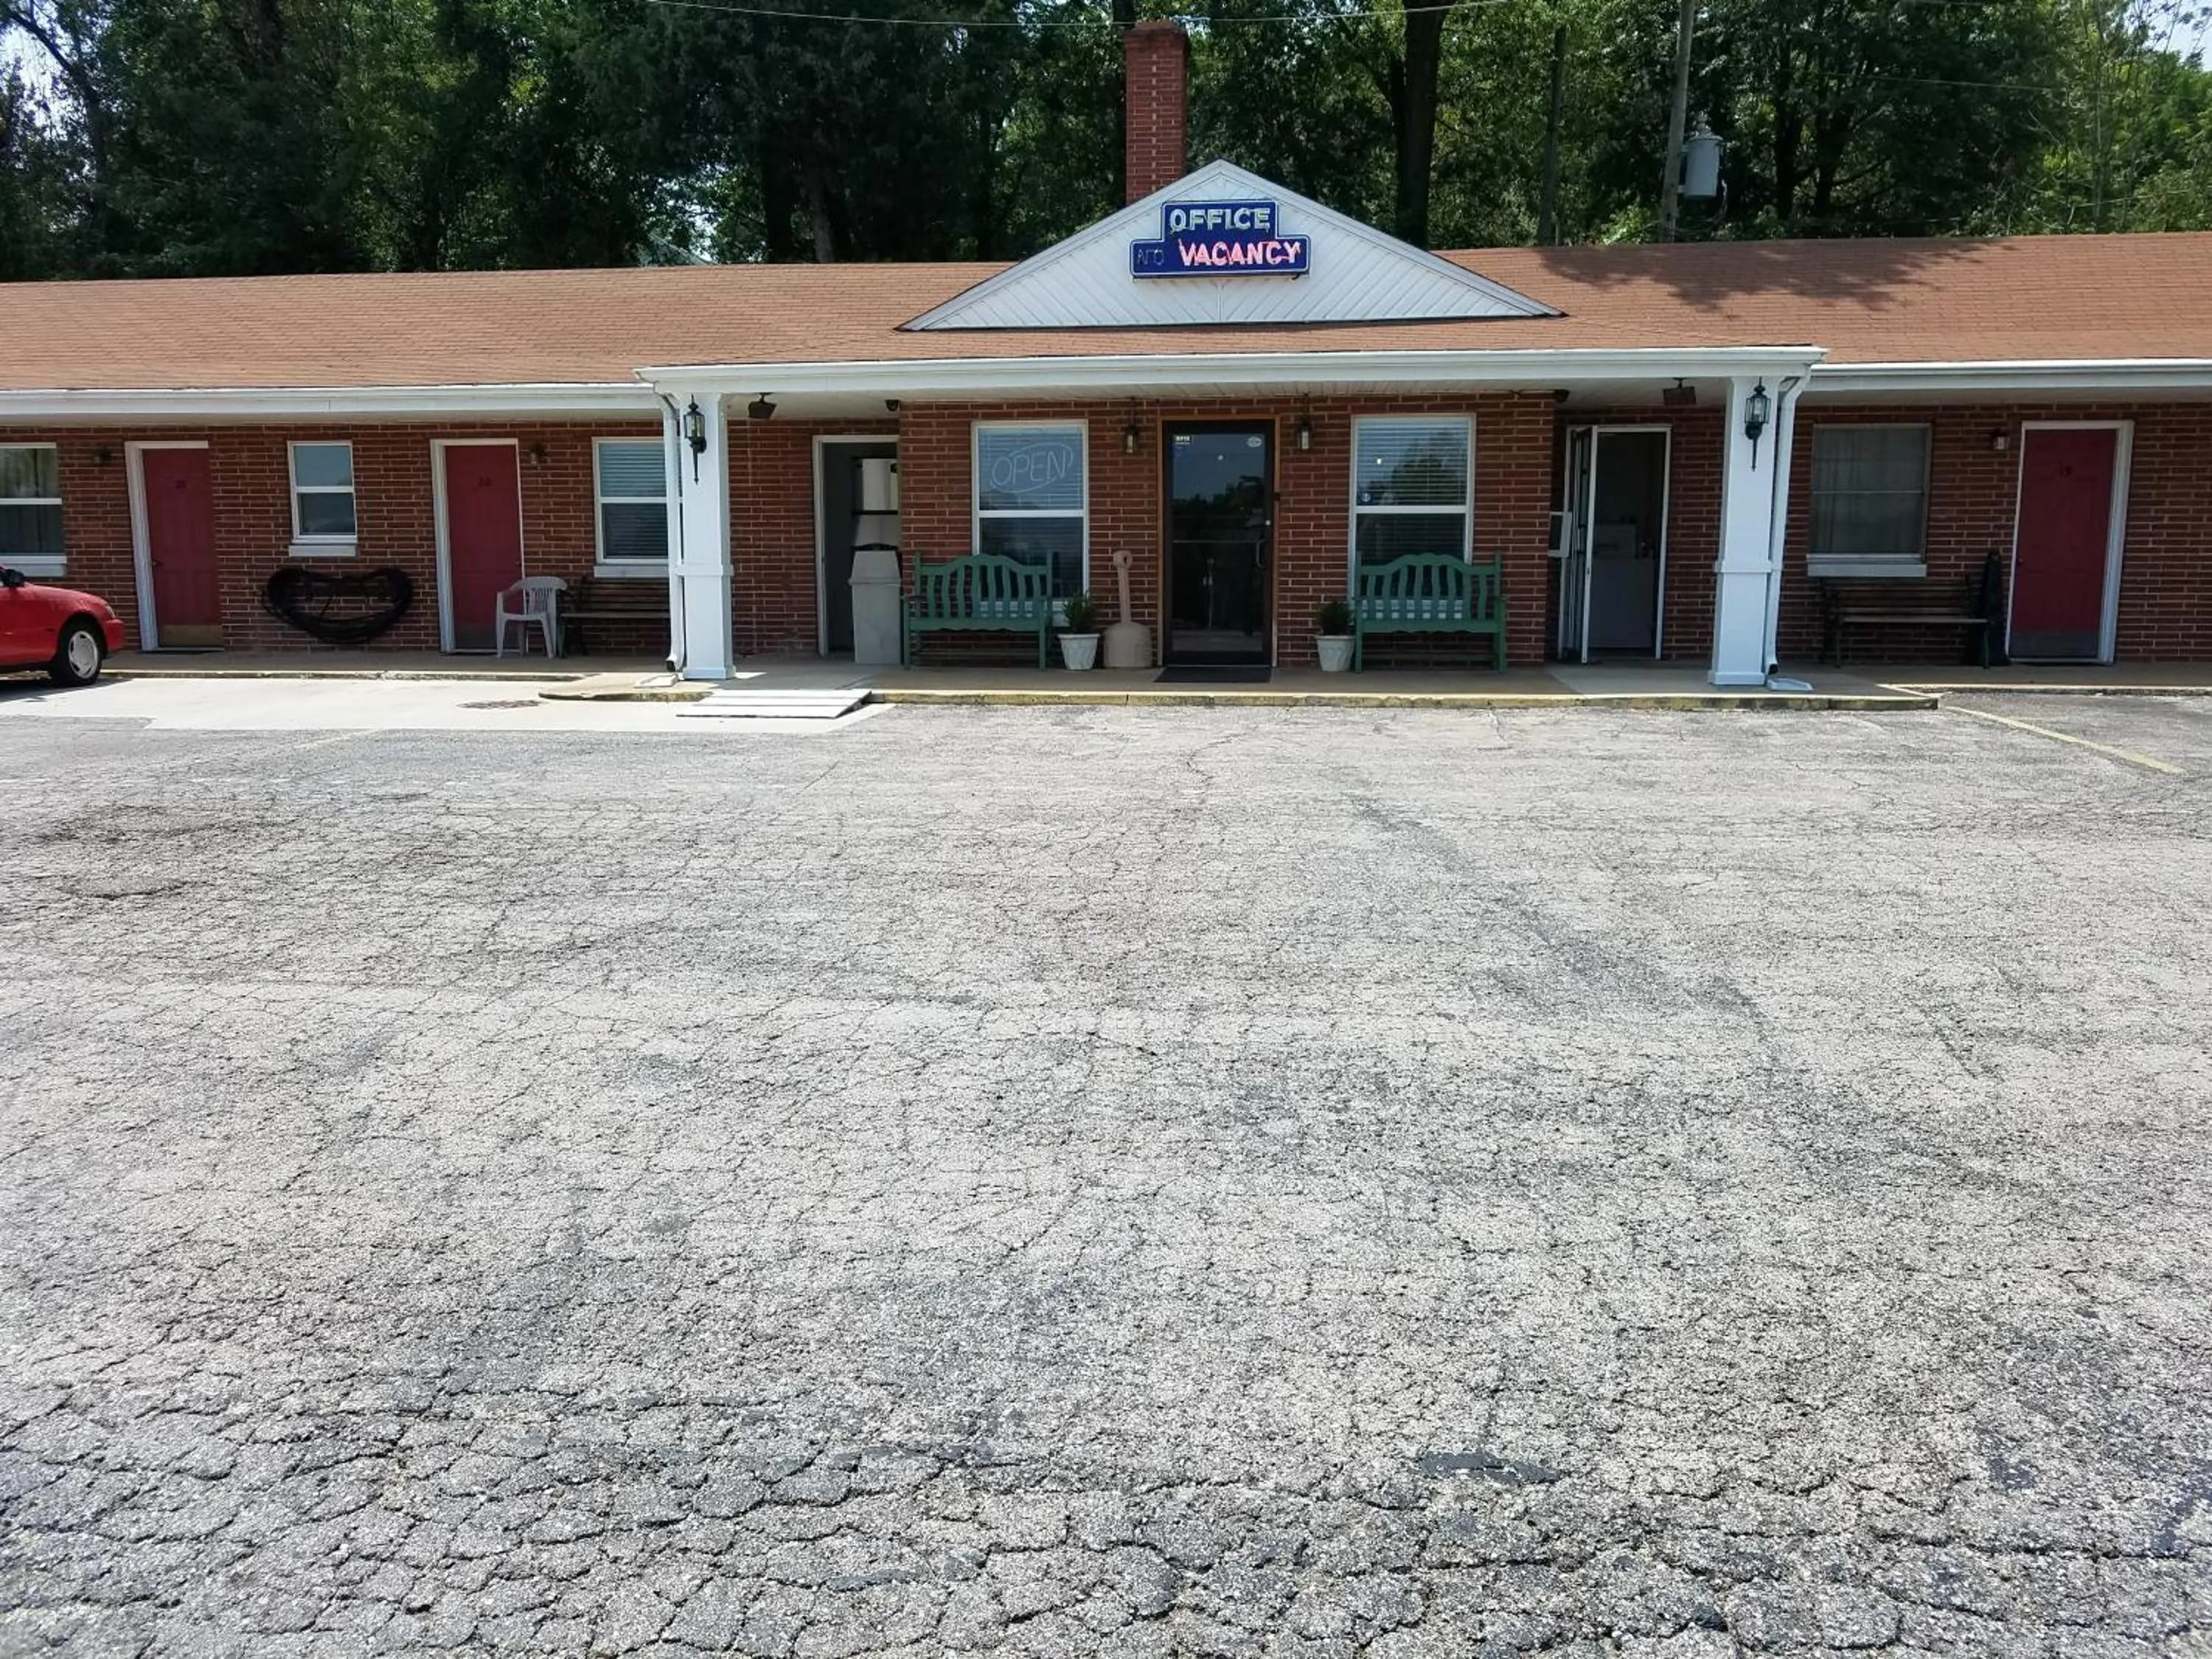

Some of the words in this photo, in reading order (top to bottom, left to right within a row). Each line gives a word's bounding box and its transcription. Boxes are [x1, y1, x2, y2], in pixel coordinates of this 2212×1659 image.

[1169, 207, 1270, 232] OFFICE
[1178, 239, 1301, 266] VACANCY
[992, 448, 1066, 486] OPEN
